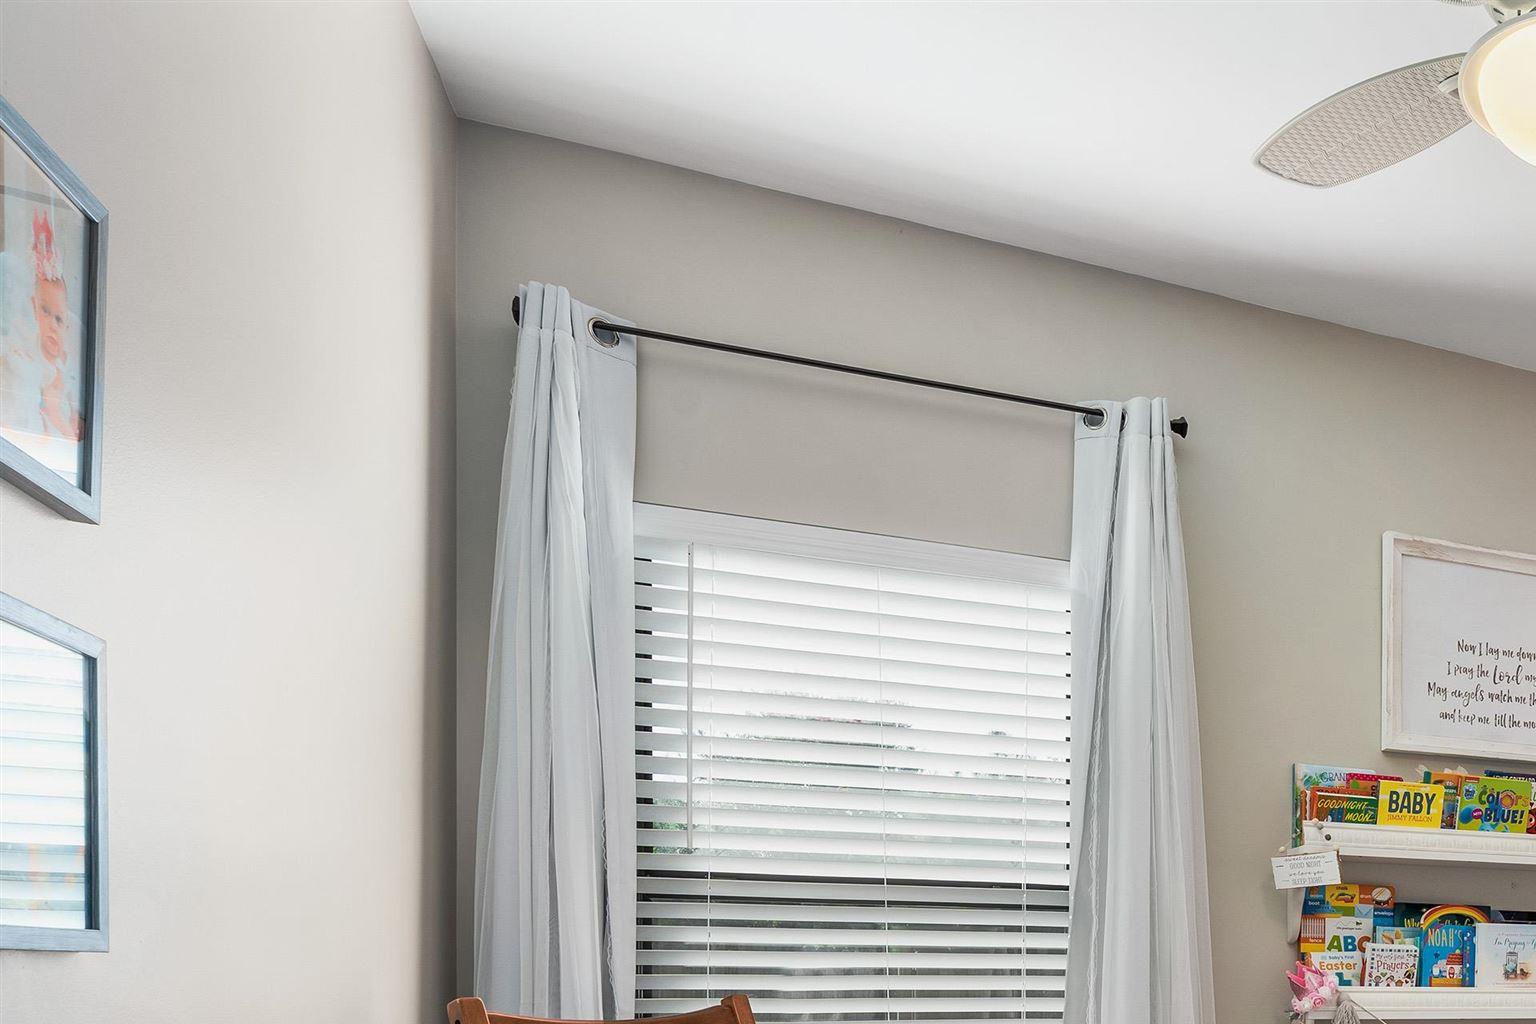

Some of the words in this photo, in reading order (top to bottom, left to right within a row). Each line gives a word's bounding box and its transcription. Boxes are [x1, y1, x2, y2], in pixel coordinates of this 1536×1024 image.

[1457, 639, 1477, 654] Now
[1478, 642, 1483, 657] I
[1485, 642, 1499, 661] lay
[1502, 648, 1514, 659] me
[1454, 665, 1473, 680] pray
[1477, 664, 1489, 678] the
[1493, 665, 1523, 685] Lord
[1427, 682, 1447, 701] May
[1451, 684, 1484, 707] angels
[1488, 690, 1513, 704] watch
[1515, 694, 1527, 705] me
[1439, 709, 1456, 723] and
[1458, 709, 1476, 725] keep
[1478, 715, 1490, 725] me
[1494, 713, 1507, 728] till
[1509, 715, 1521, 729] the
[1319, 772, 1346, 783] GRAN
[1318, 799, 1367, 811] GOODNIGHT
[1388, 791, 1436, 815] BABY
[1345, 812, 1372, 822] MOON
[1484, 810, 1525, 825] BLUE!
[1327, 935, 1371, 953] ABC
[1428, 928, 1463, 948] NOAH'S
[1319, 961, 1357, 970] Easter
[1376, 960, 1410, 973] Prayers
